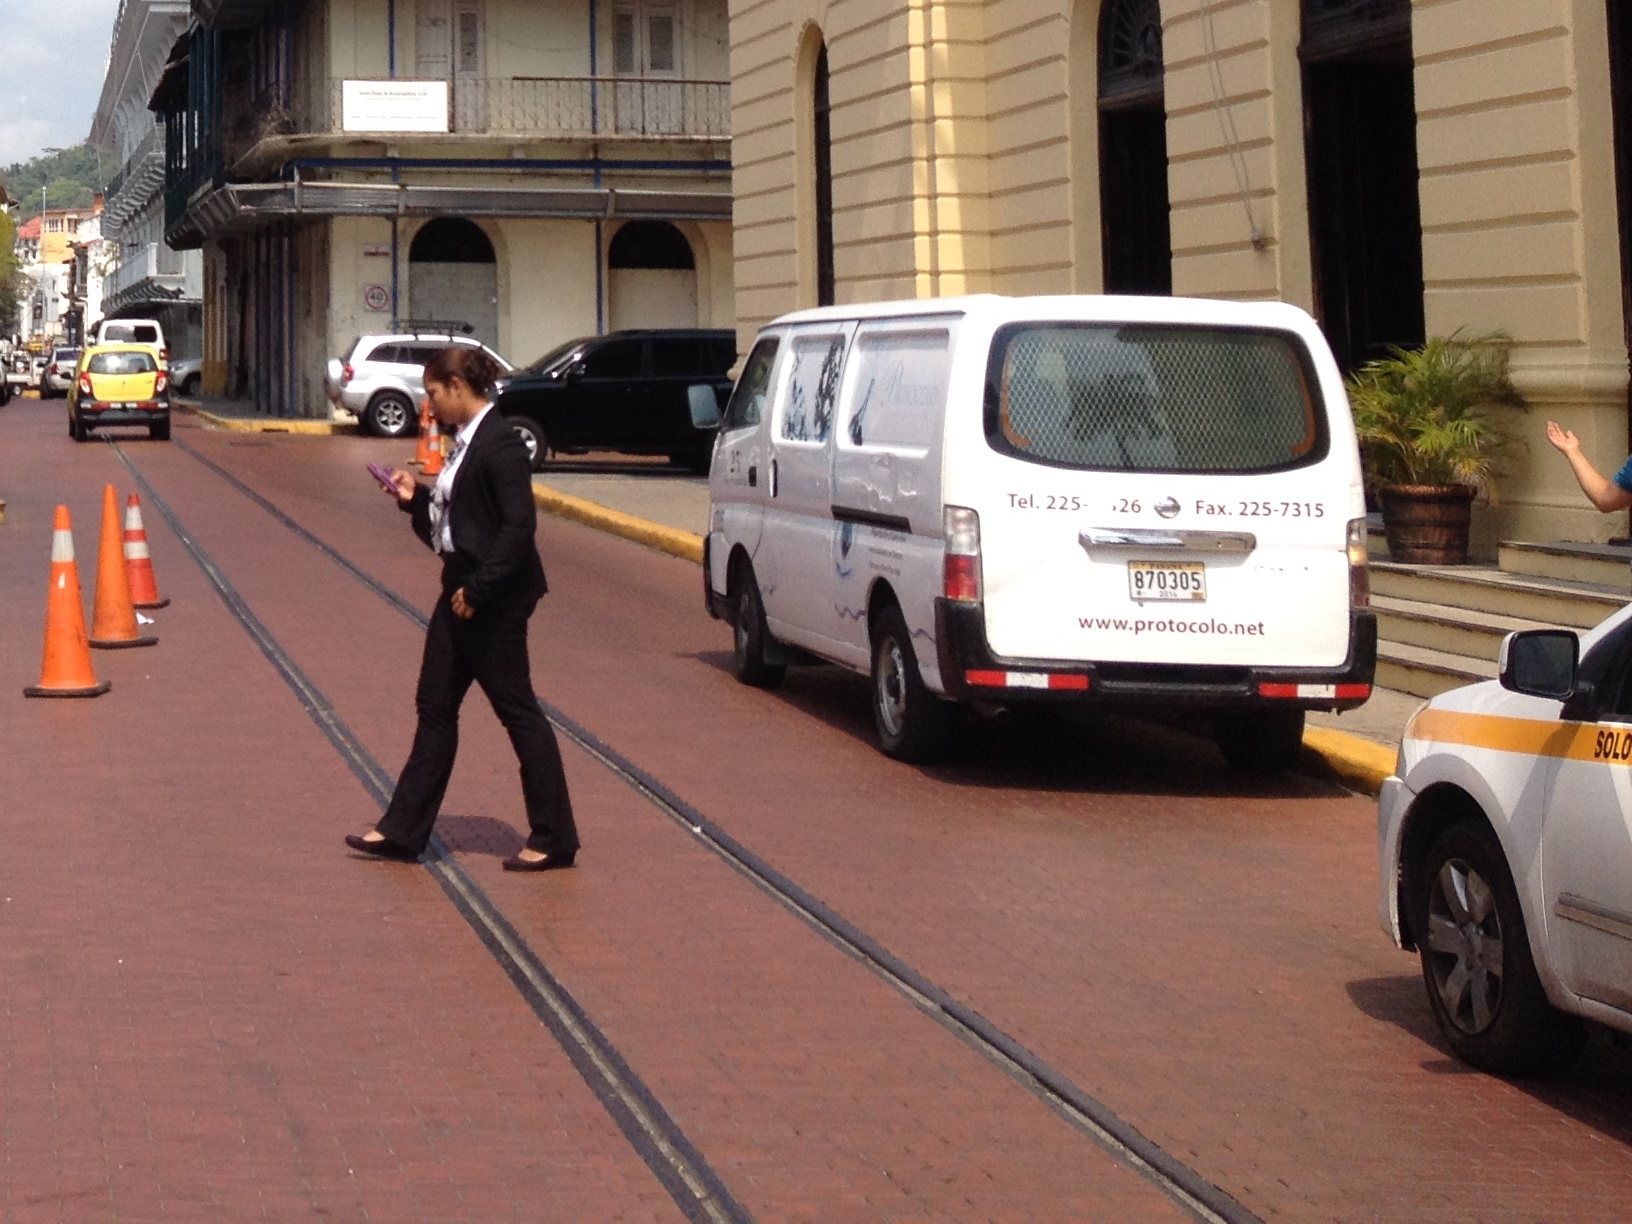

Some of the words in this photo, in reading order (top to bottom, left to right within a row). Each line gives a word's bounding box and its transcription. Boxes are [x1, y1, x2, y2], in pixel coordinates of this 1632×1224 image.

[1007, 493, 1040, 509] Tel.
[1195, 500, 1233, 516] Fax.
[1238, 501, 1324, 518] 225-7315
[1134, 570, 1201, 590] 870305
[1079, 616, 1265, 636] www.protocolo.net
[1594, 729, 1632, 761] SOLO
